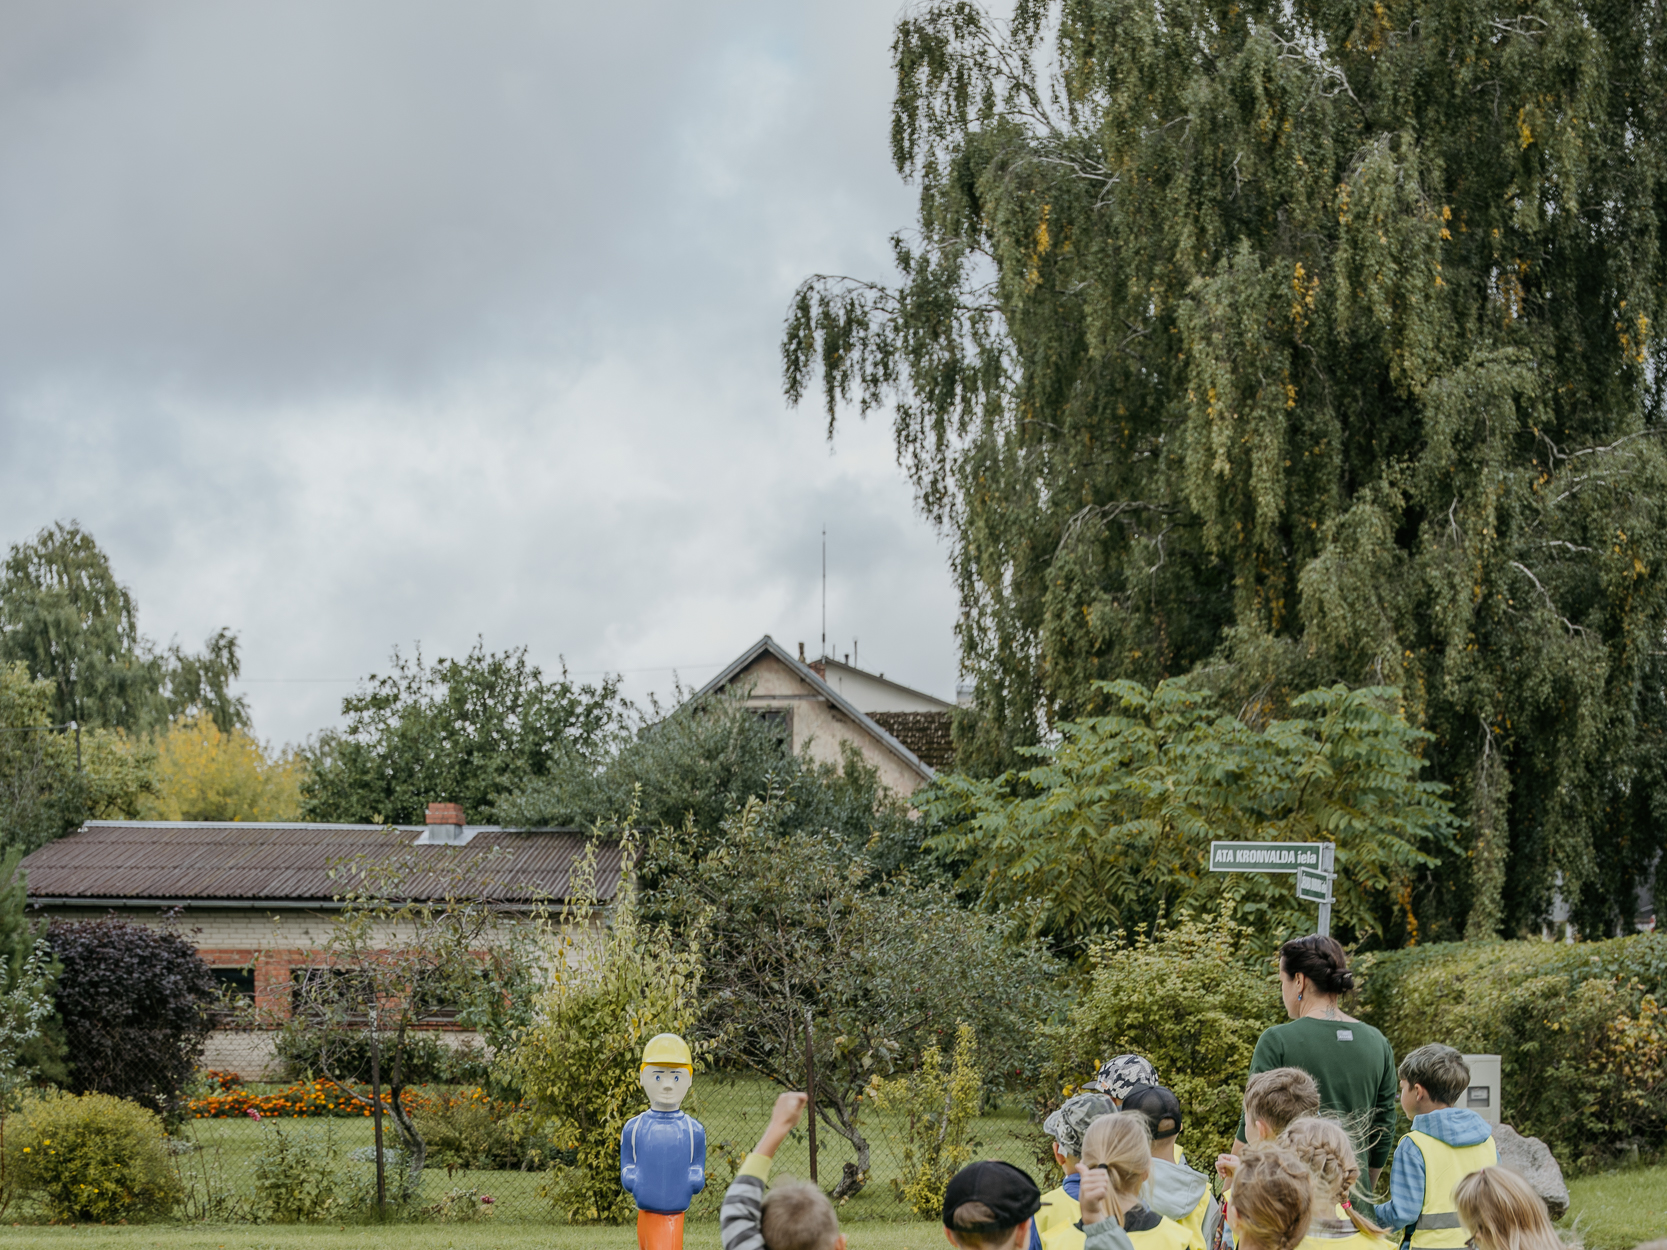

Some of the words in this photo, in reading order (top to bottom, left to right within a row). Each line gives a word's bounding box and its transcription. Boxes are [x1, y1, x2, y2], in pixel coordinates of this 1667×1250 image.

[1214, 849, 1234, 863] ATA
[1235, 849, 1296, 864] KRONVALDA
[1297, 850, 1317, 864] iela
